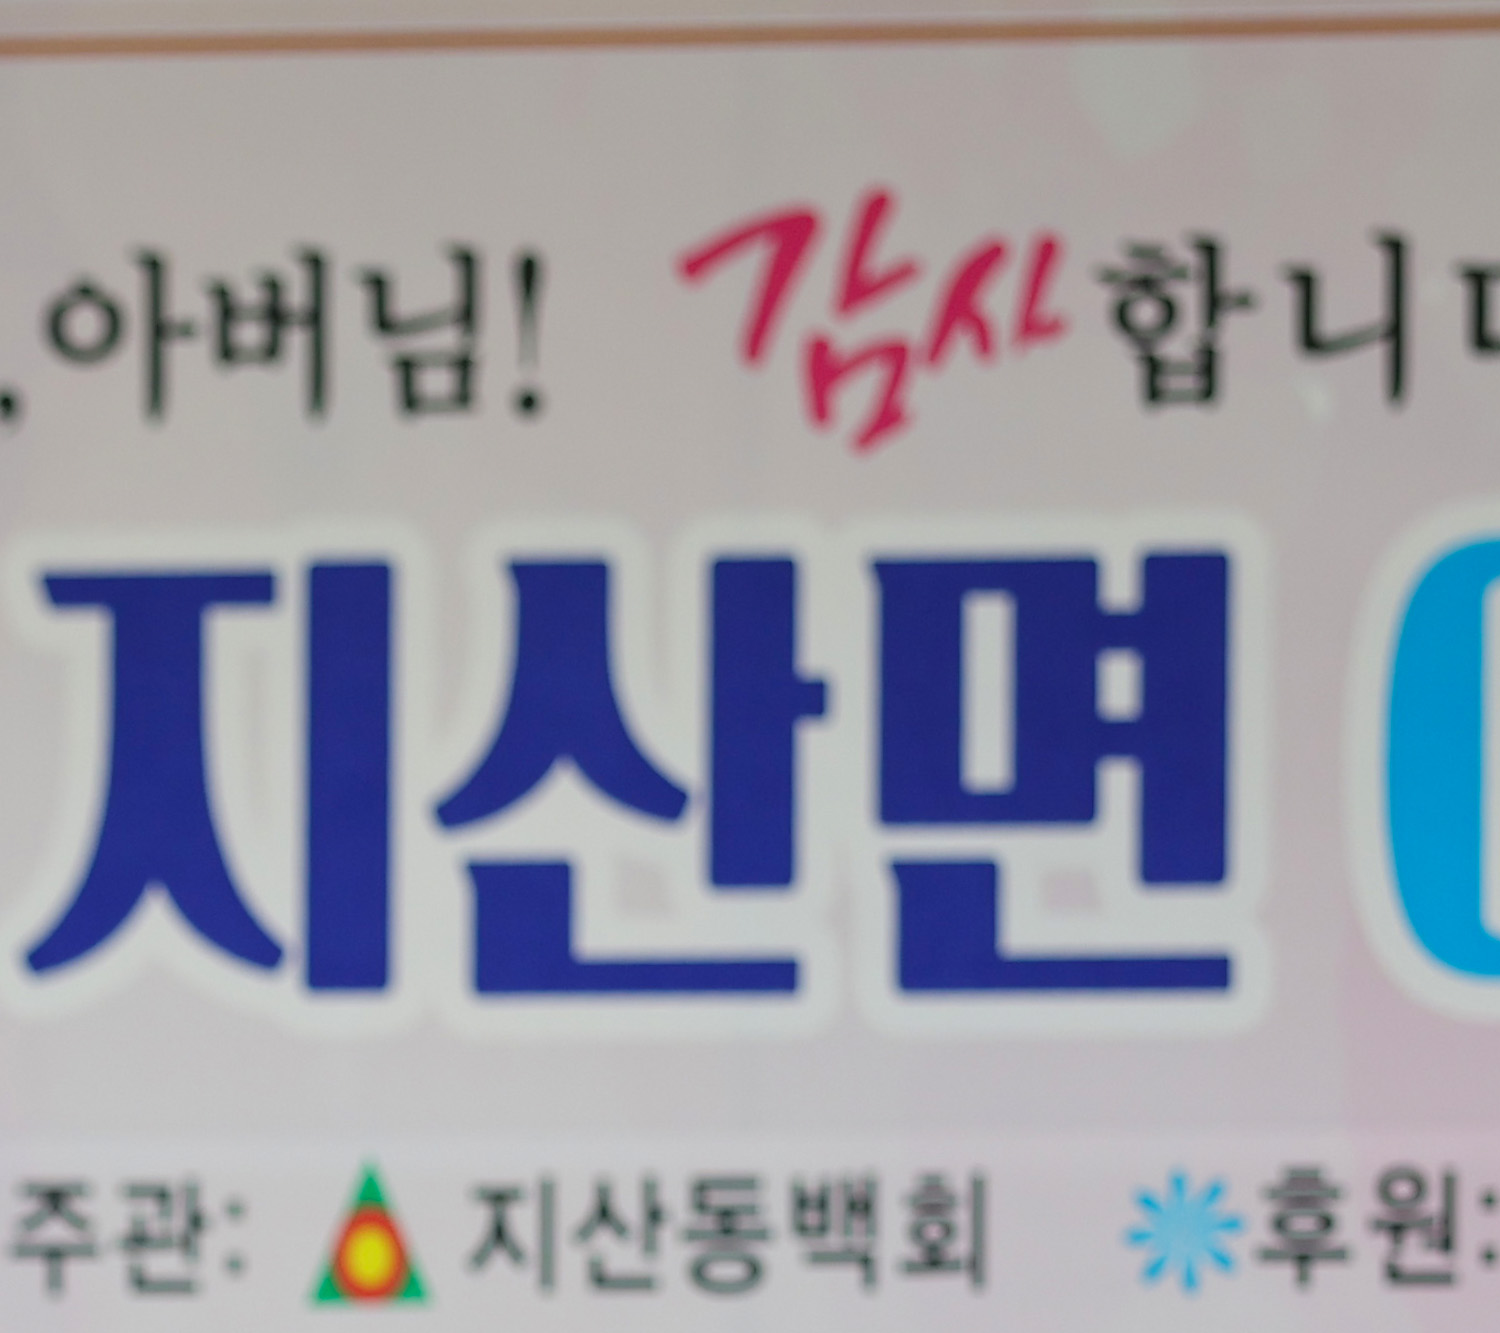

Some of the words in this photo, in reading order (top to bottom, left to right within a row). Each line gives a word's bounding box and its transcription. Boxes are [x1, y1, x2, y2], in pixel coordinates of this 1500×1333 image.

[20, 544, 1235, 1000] 지산면
[10, 1175, 244, 1296] 주관:
[465, 1170, 990, 1296] 지산동백회
[1255, 1165, 1499, 1288] 후원:
